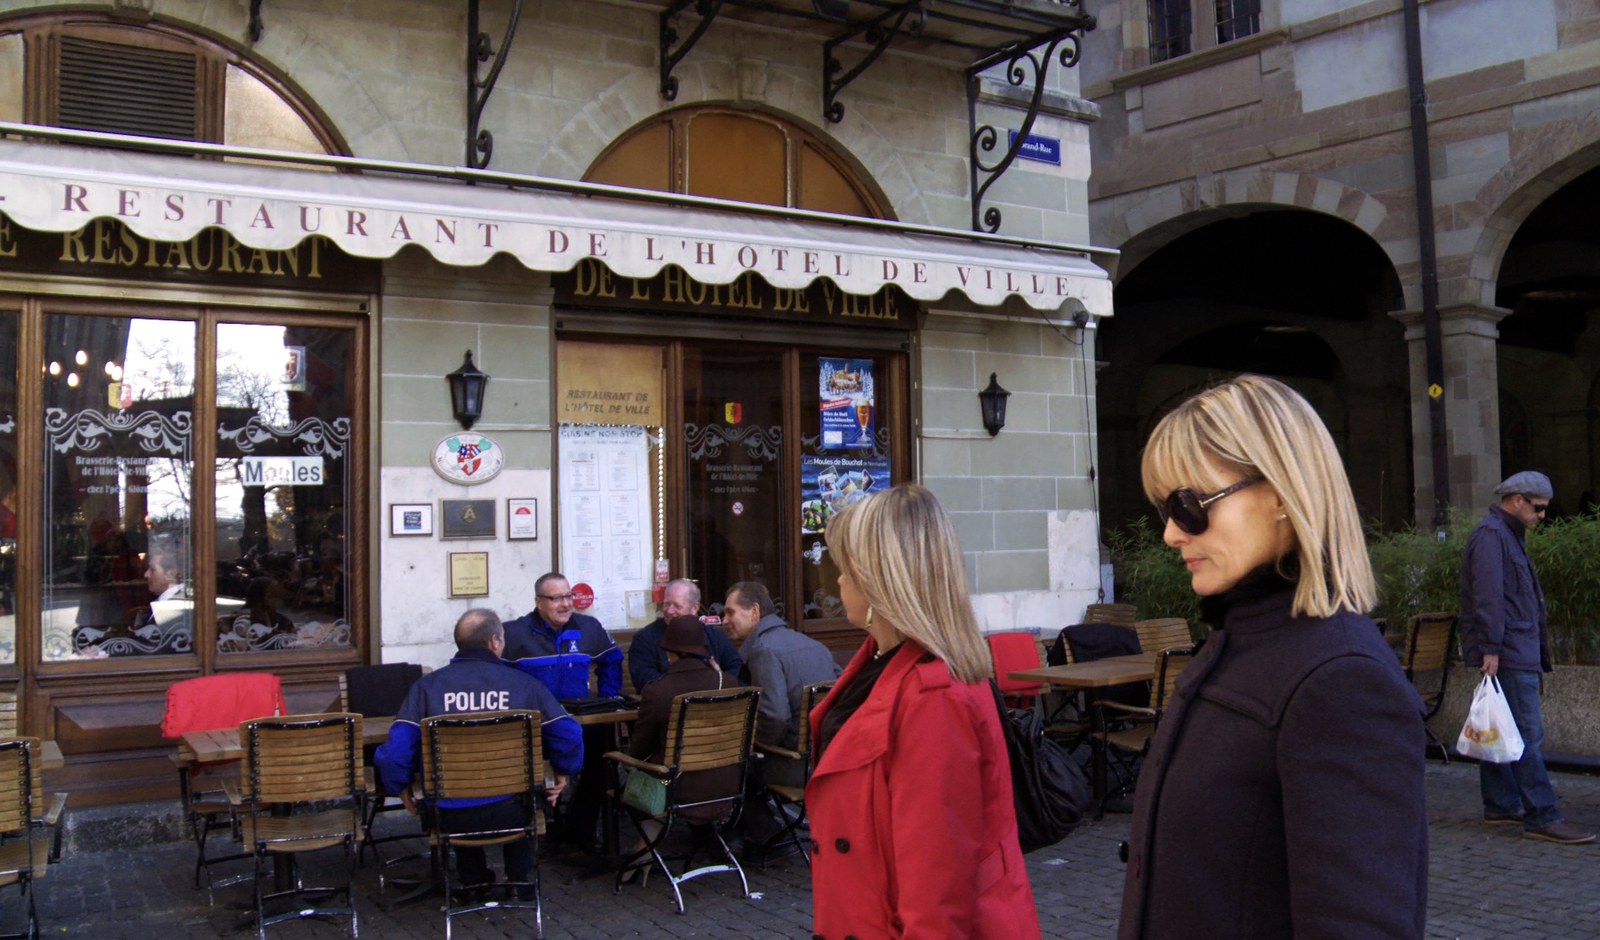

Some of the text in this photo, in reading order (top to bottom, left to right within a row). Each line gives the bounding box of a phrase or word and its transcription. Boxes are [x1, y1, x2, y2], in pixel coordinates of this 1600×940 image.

[1021, 142, 1053, 153] rand-Rue
[62, 183, 499, 248] RESTAURANT
[547, 229, 607, 257] DE
[646, 237, 850, 277] L'HOTEL
[881, 259, 928, 284] DE
[956, 265, 1070, 296] VILLE
[567, 389, 649, 402] RESTAURANT DE
[609, 405, 621, 414] DE
[625, 406, 651, 415] VILLE
[814, 458, 833, 466] Moules
[841, 458, 863, 467] Bouchot
[444, 691, 510, 712] POLICE
